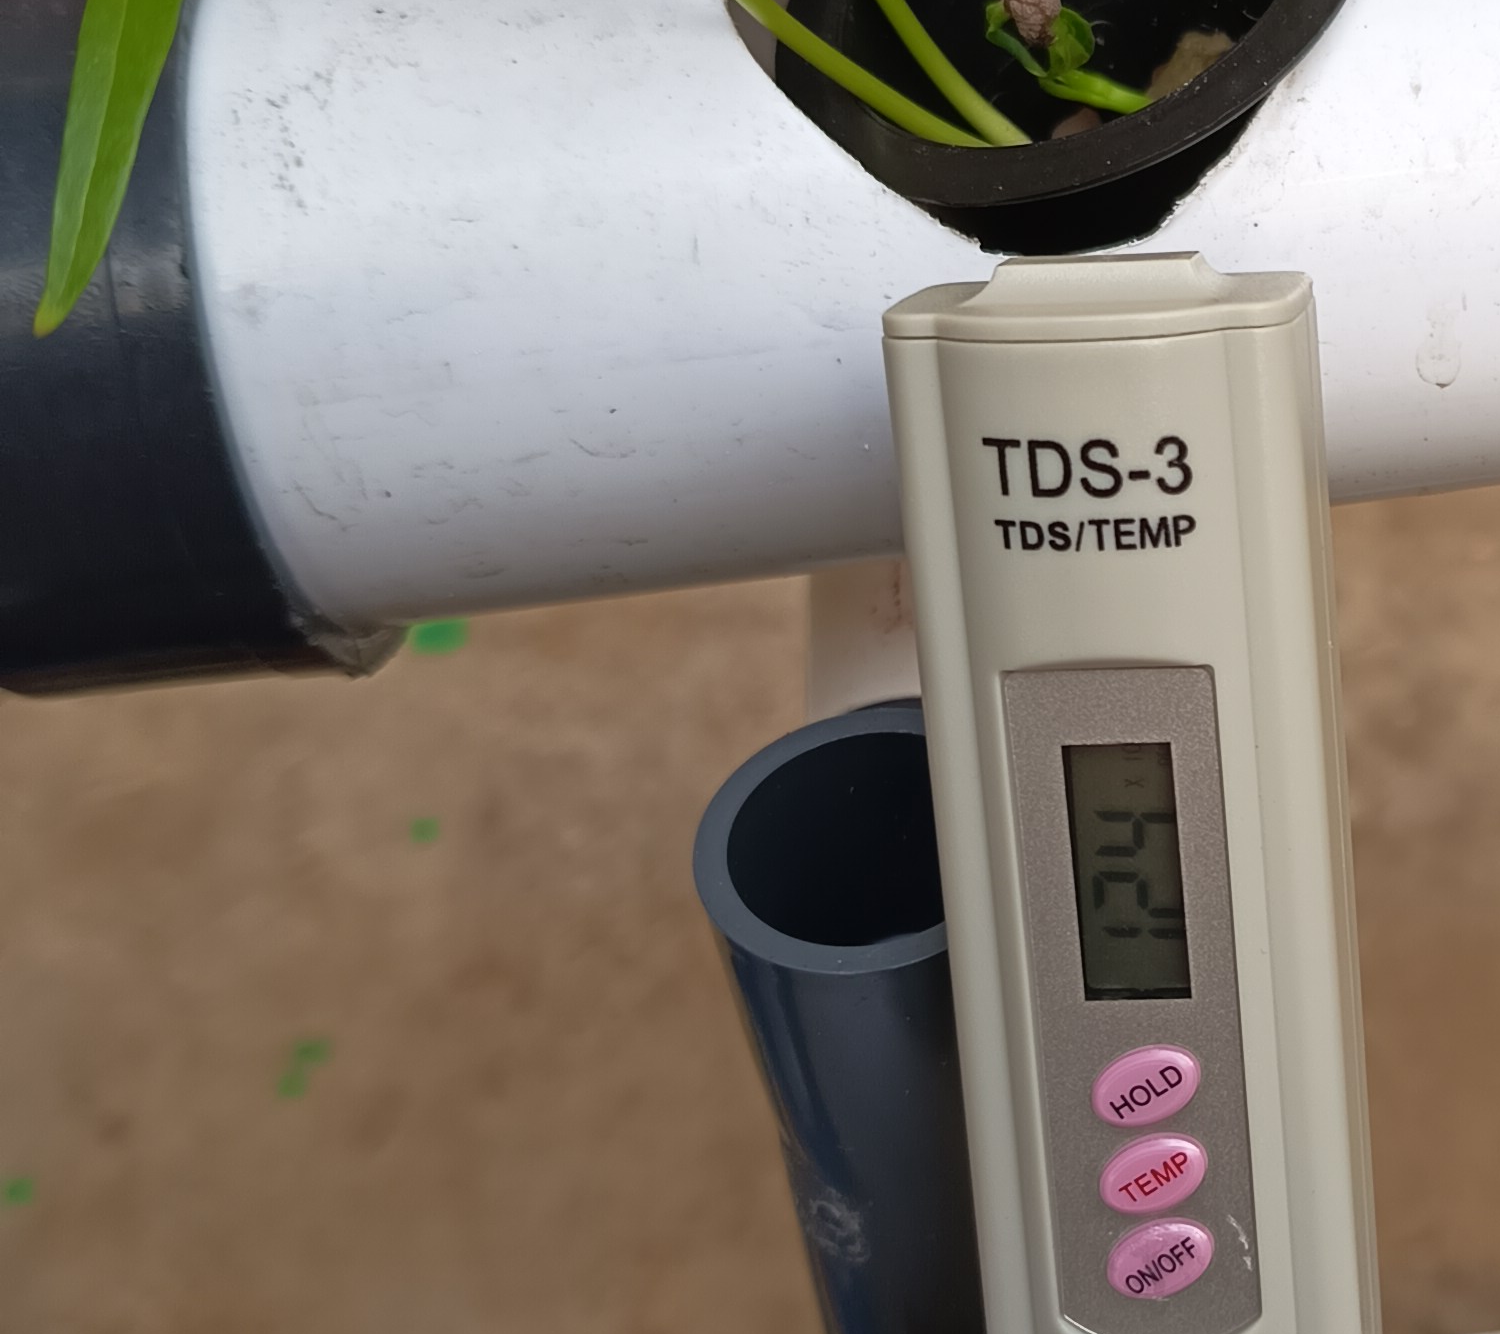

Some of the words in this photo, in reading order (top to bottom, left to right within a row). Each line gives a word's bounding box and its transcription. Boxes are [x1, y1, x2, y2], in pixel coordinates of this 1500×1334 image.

[982, 436, 1193, 498] TDS-3
[994, 514, 1196, 552] TDS/TEMP
[1092, 810, 1187, 940] 124
[1109, 1065, 1183, 1120] HOLD
[1118, 1151, 1188, 1202] TEMP
[1125, 1237, 1196, 1294] ON/OFF
